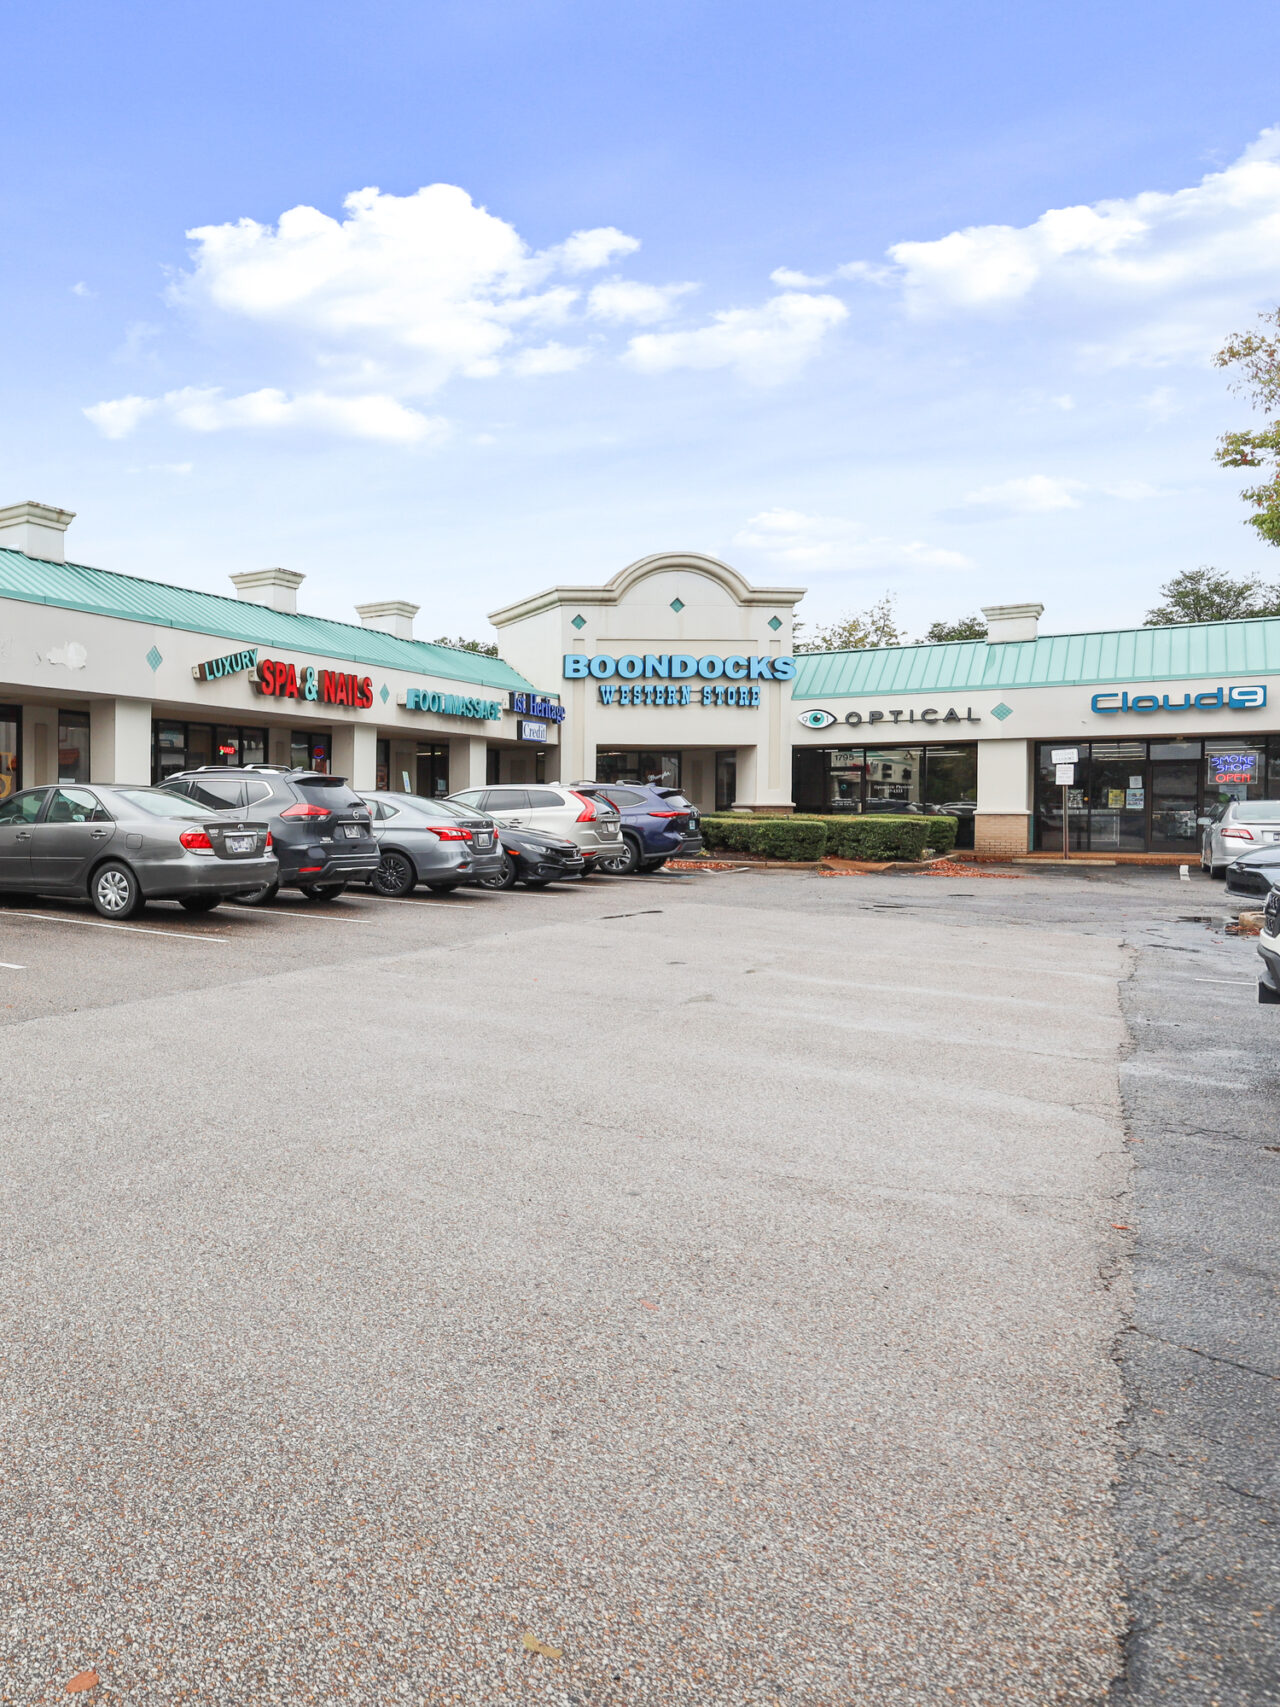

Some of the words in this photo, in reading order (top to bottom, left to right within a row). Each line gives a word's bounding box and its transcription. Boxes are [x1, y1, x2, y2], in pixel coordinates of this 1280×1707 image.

[204, 648, 258, 680] LUXURY
[564, 654, 797, 680] BOONDOCKS
[260, 659, 299, 698] SPA
[303, 666, 317, 701] &
[321, 670, 373, 708] NAILS
[407, 688, 445, 713] FOOT
[445, 694, 502, 721] MASSAGE
[599, 685, 691, 705] WESTERN
[702, 686, 761, 706] STORE
[513, 691, 526, 712] 1st
[530, 694, 566, 724] Heritage
[845, 707, 981, 727] OPTICAL
[523, 722, 547, 740] Credit
[834, 753, 855, 762] 1795
[1211, 754, 1255, 766] SMOKE
[1215, 773, 1252, 783] OPEN
[1216, 763, 1252, 773] SHOP
